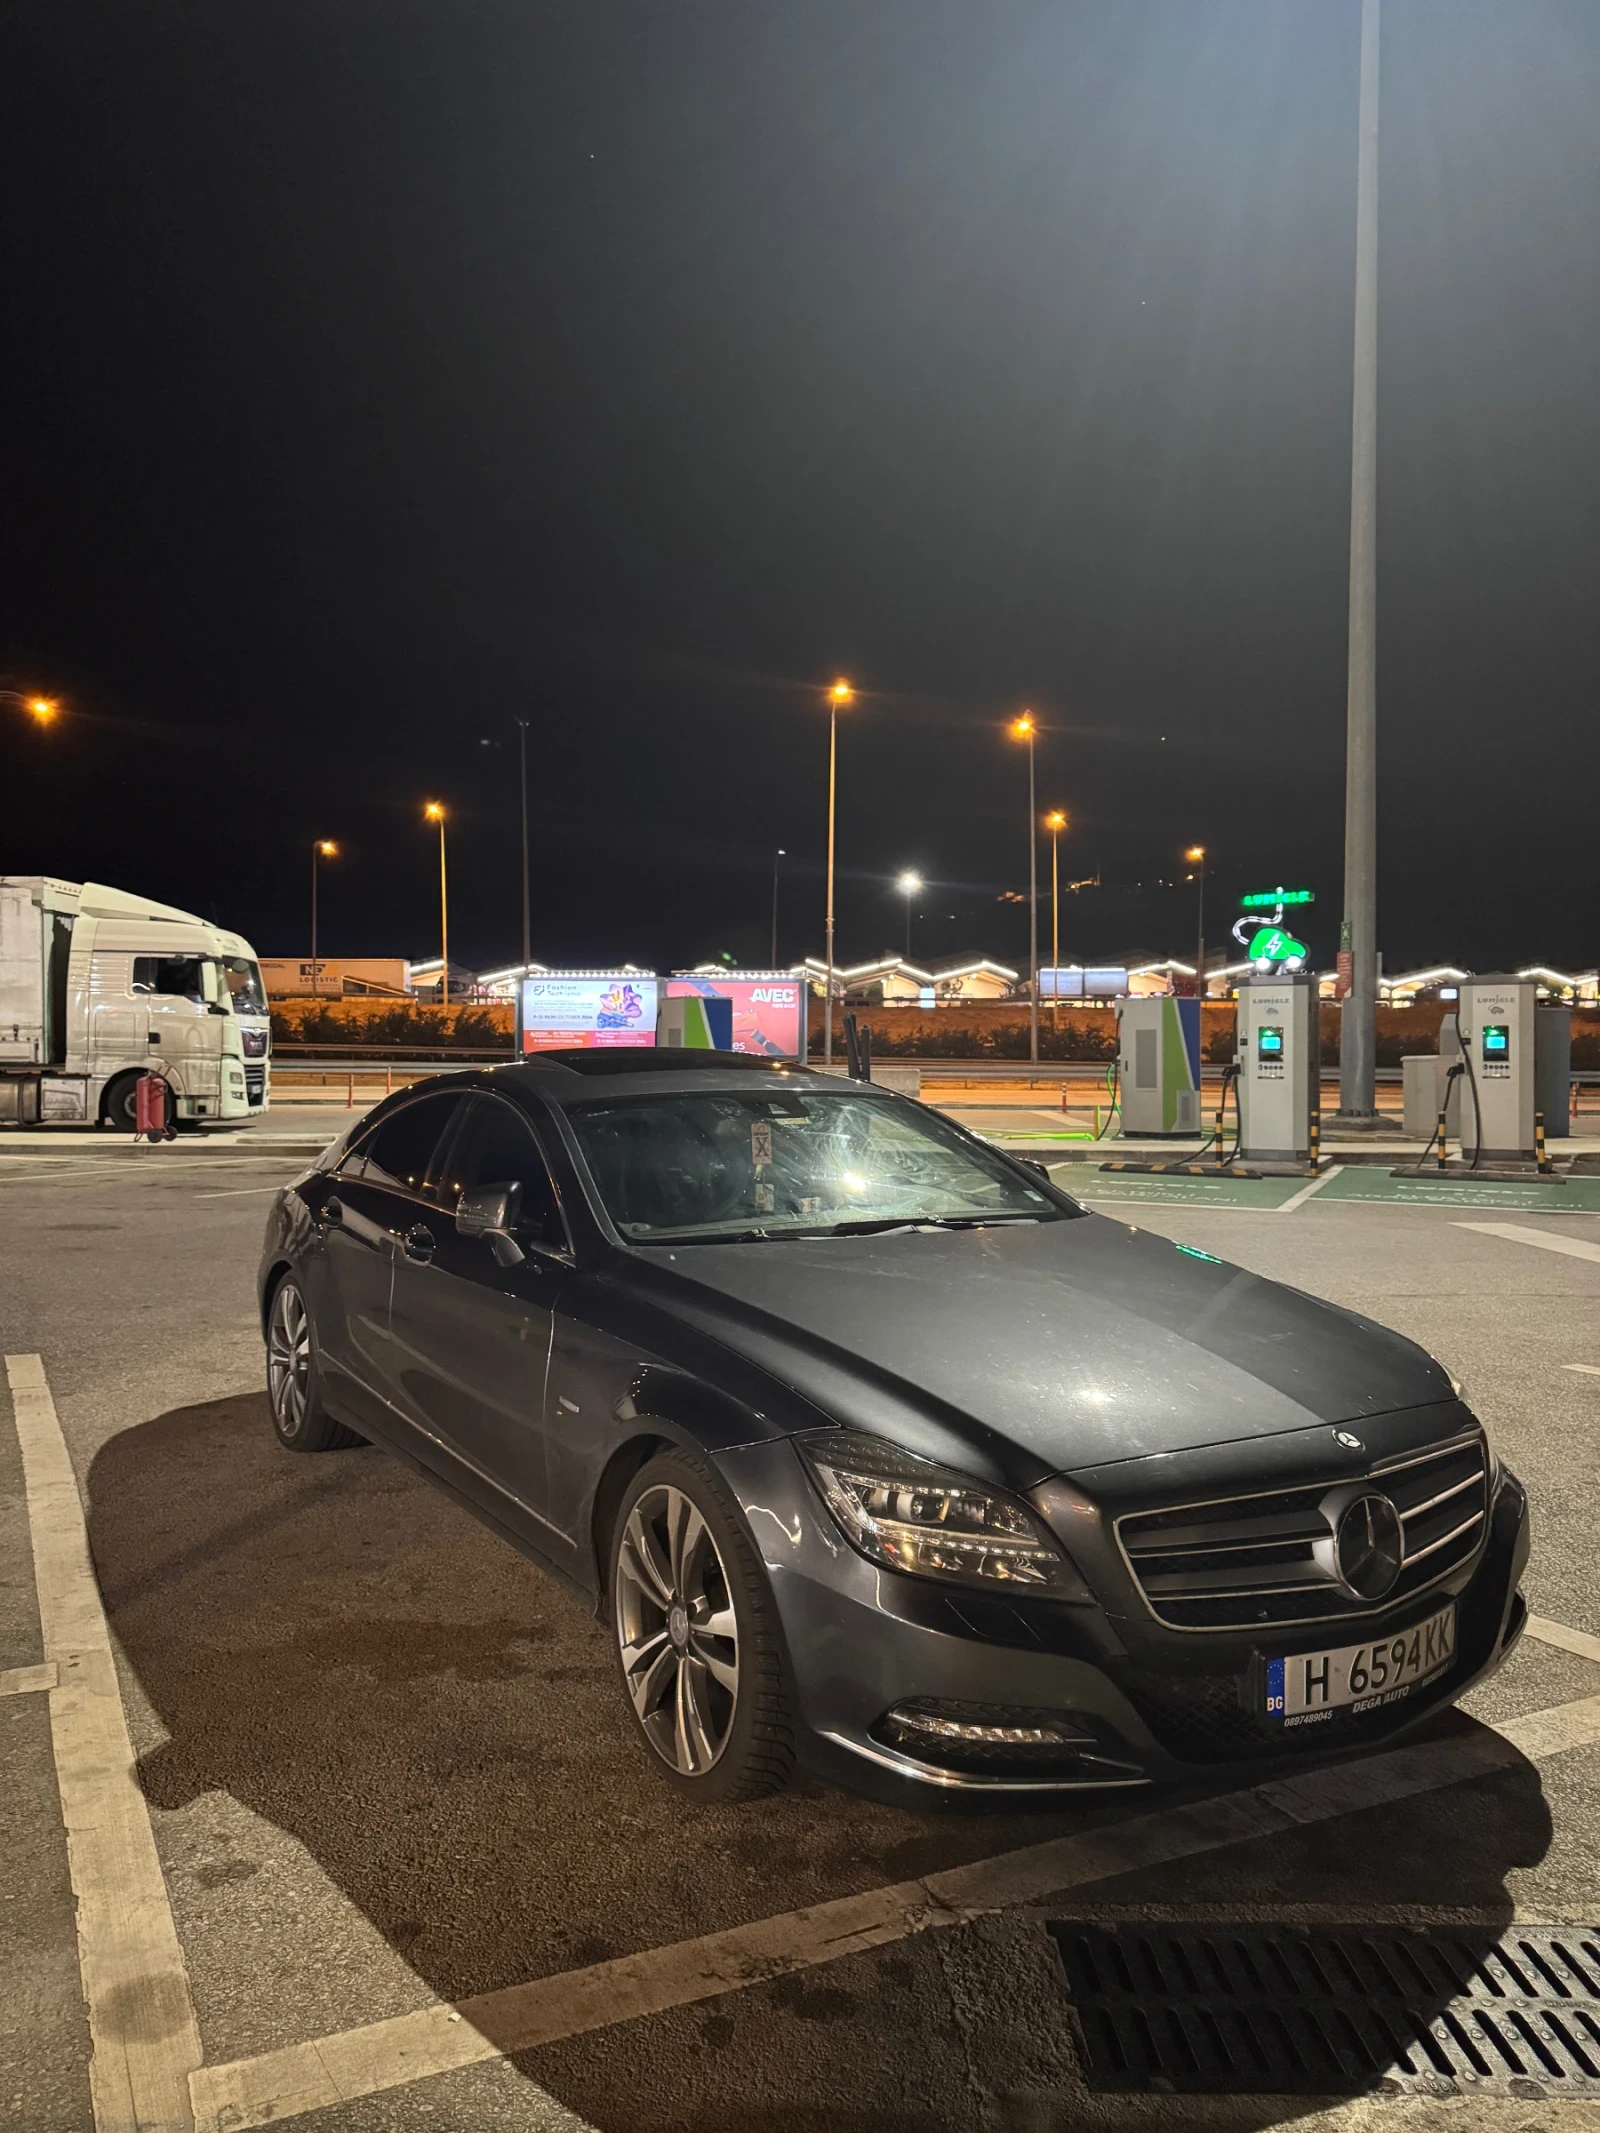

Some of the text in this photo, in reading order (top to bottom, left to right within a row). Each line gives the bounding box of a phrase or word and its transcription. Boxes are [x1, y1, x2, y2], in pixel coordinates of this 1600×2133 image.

[749, 988, 795, 1003] AVEC
[1305, 1656, 1330, 1706] H
[1266, 1695, 1283, 1711] BG
[1352, 1686, 1410, 1713] DEGA AUTO
